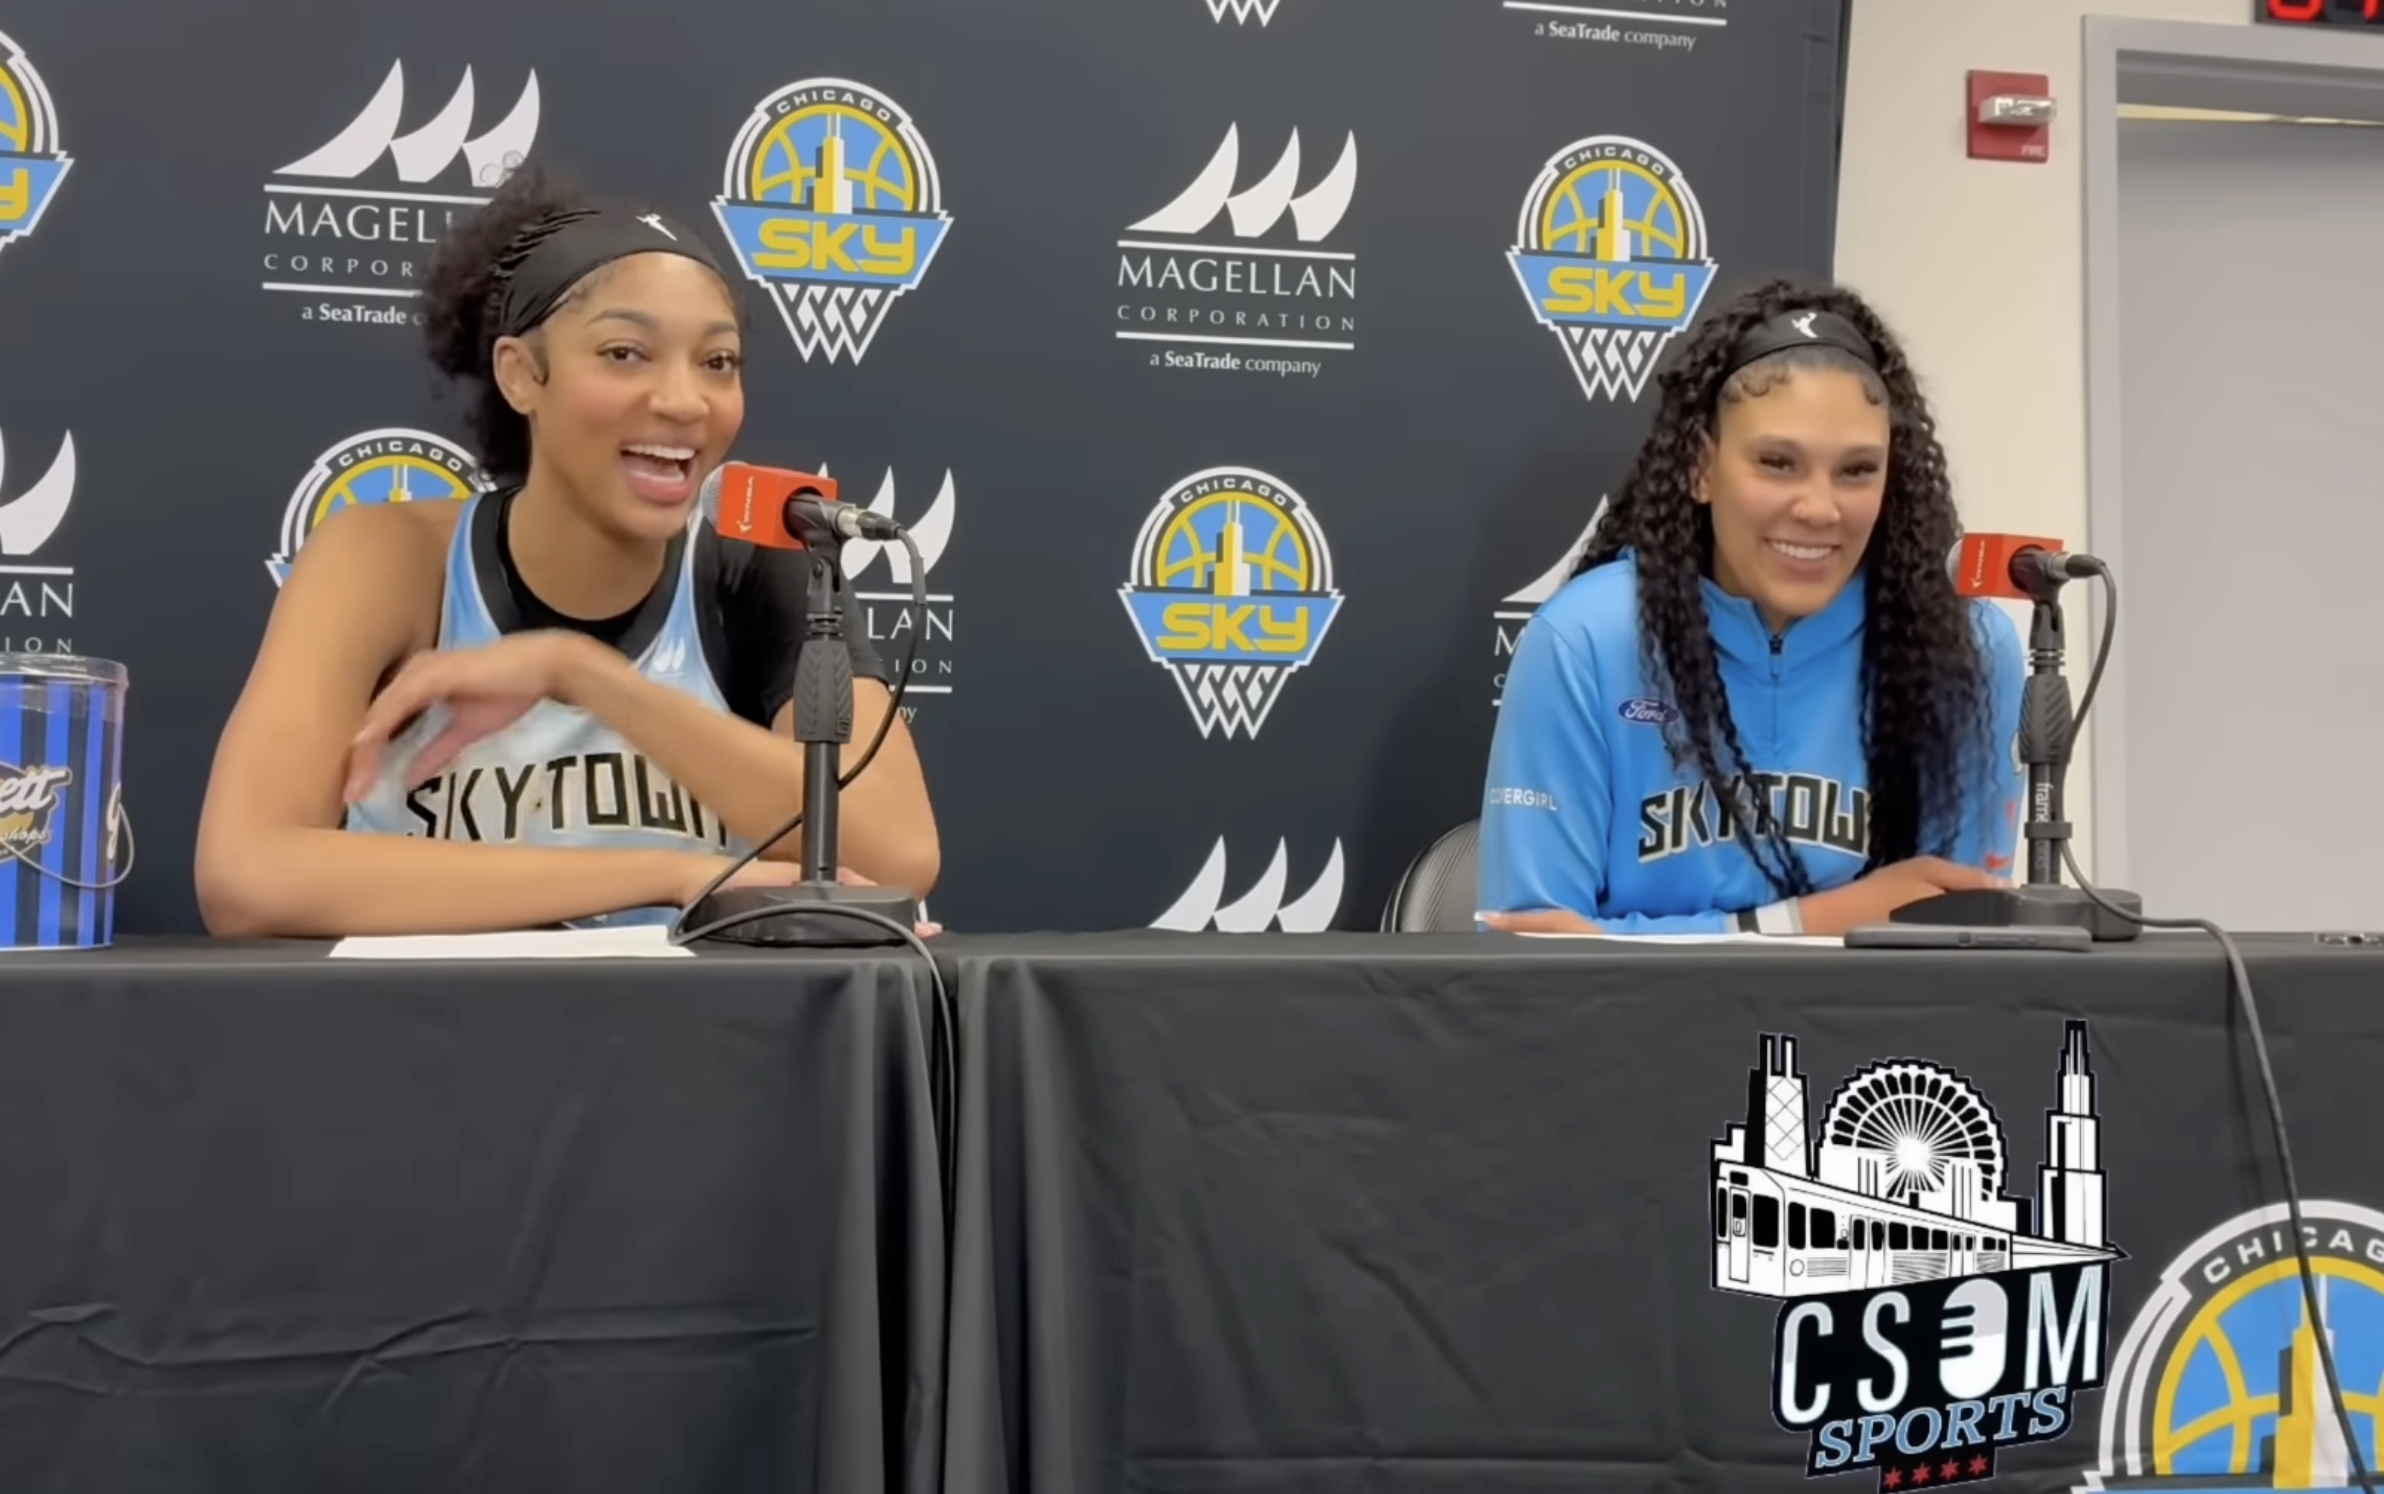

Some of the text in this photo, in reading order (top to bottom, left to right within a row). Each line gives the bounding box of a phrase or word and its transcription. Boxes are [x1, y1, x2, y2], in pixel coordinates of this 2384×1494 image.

[1535, 20, 1697, 52] a SeaTrade company
[777, 89, 891, 122] CHICAGO
[1564, 146, 1665, 176] CHICAGO
[264, 199, 451, 243] MAGEL
[752, 218, 916, 276] SKY
[263, 253, 414, 277] CORPOR
[1118, 254, 1356, 299] MAGELLAN
[1543, 266, 1686, 318] SKY
[302, 306, 313, 320] a
[319, 303, 407, 324] SeaTrade
[1117, 305, 1354, 331] CORPORATION
[1150, 350, 1321, 378] a SeaTrade company
[338, 440, 463, 472] CHICAGO
[1180, 478, 1287, 507] CHICAGO
[1157, 603, 1309, 652] SKY
[1624, 700, 1669, 723] Ford
[1638, 772, 1869, 863] SKYTOW
[2203, 1226, 2384, 1284] CHICAG
